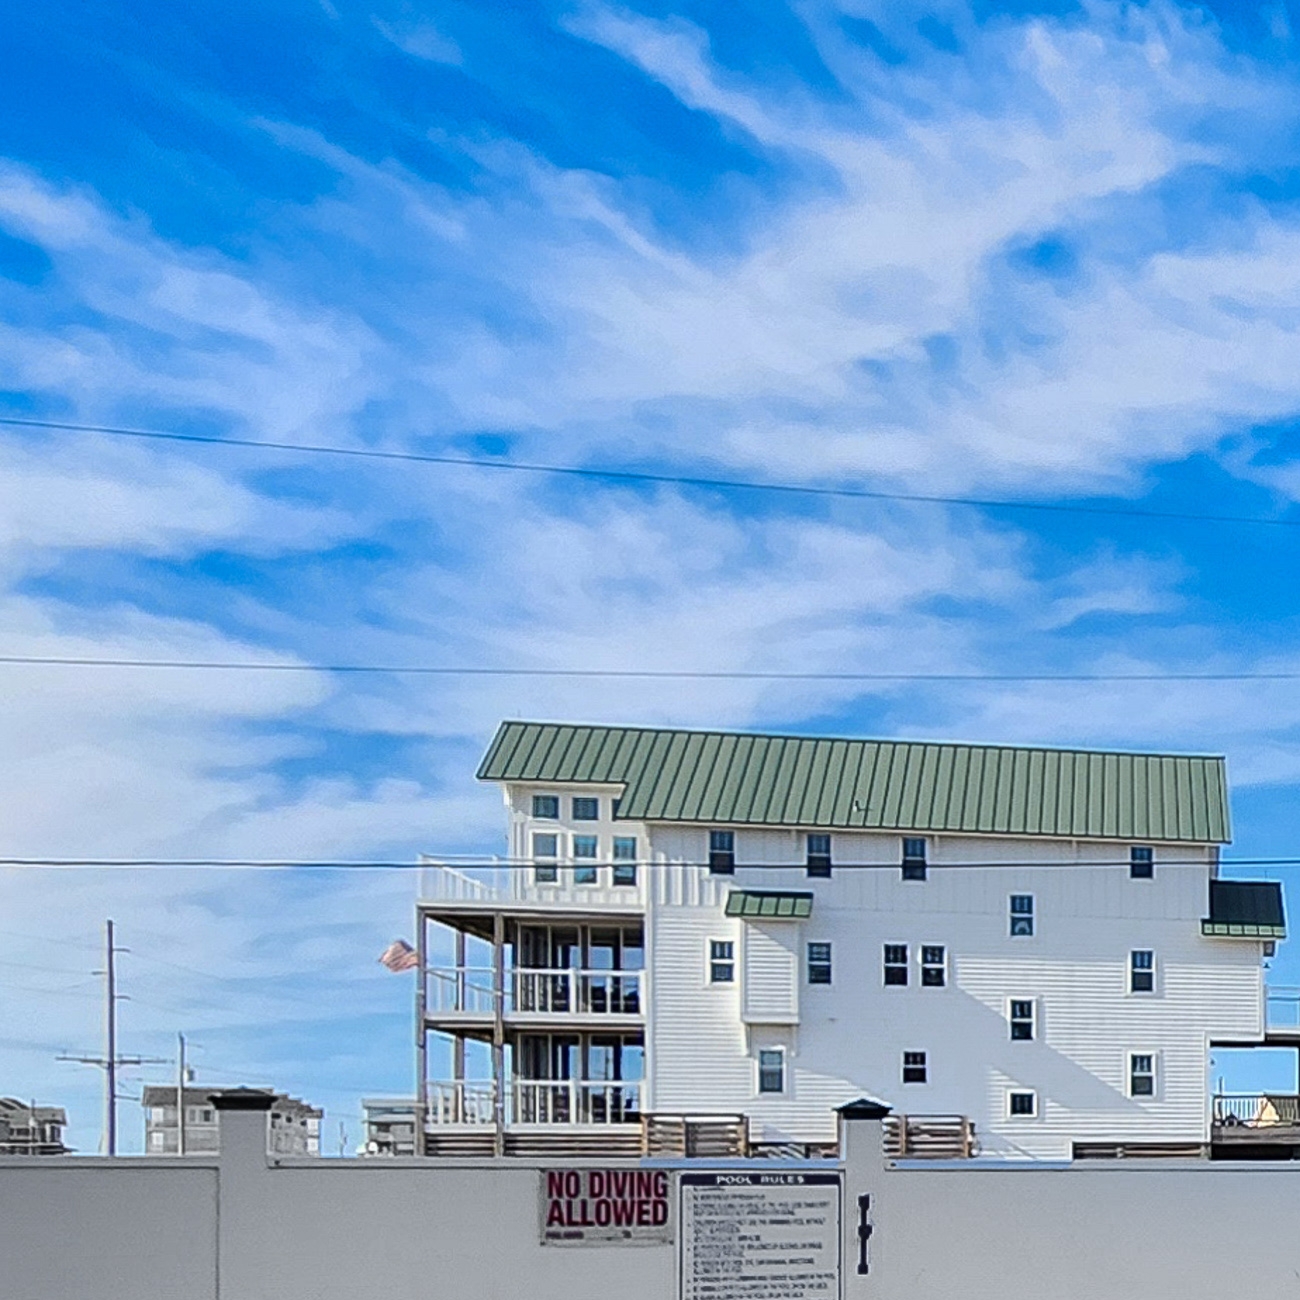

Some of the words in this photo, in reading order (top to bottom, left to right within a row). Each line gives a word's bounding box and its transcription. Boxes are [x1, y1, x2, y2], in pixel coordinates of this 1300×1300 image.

[547, 1171, 580, 1199] NO
[589, 1171, 668, 1199] DIVING
[546, 1199, 668, 1227] ALLOWED
